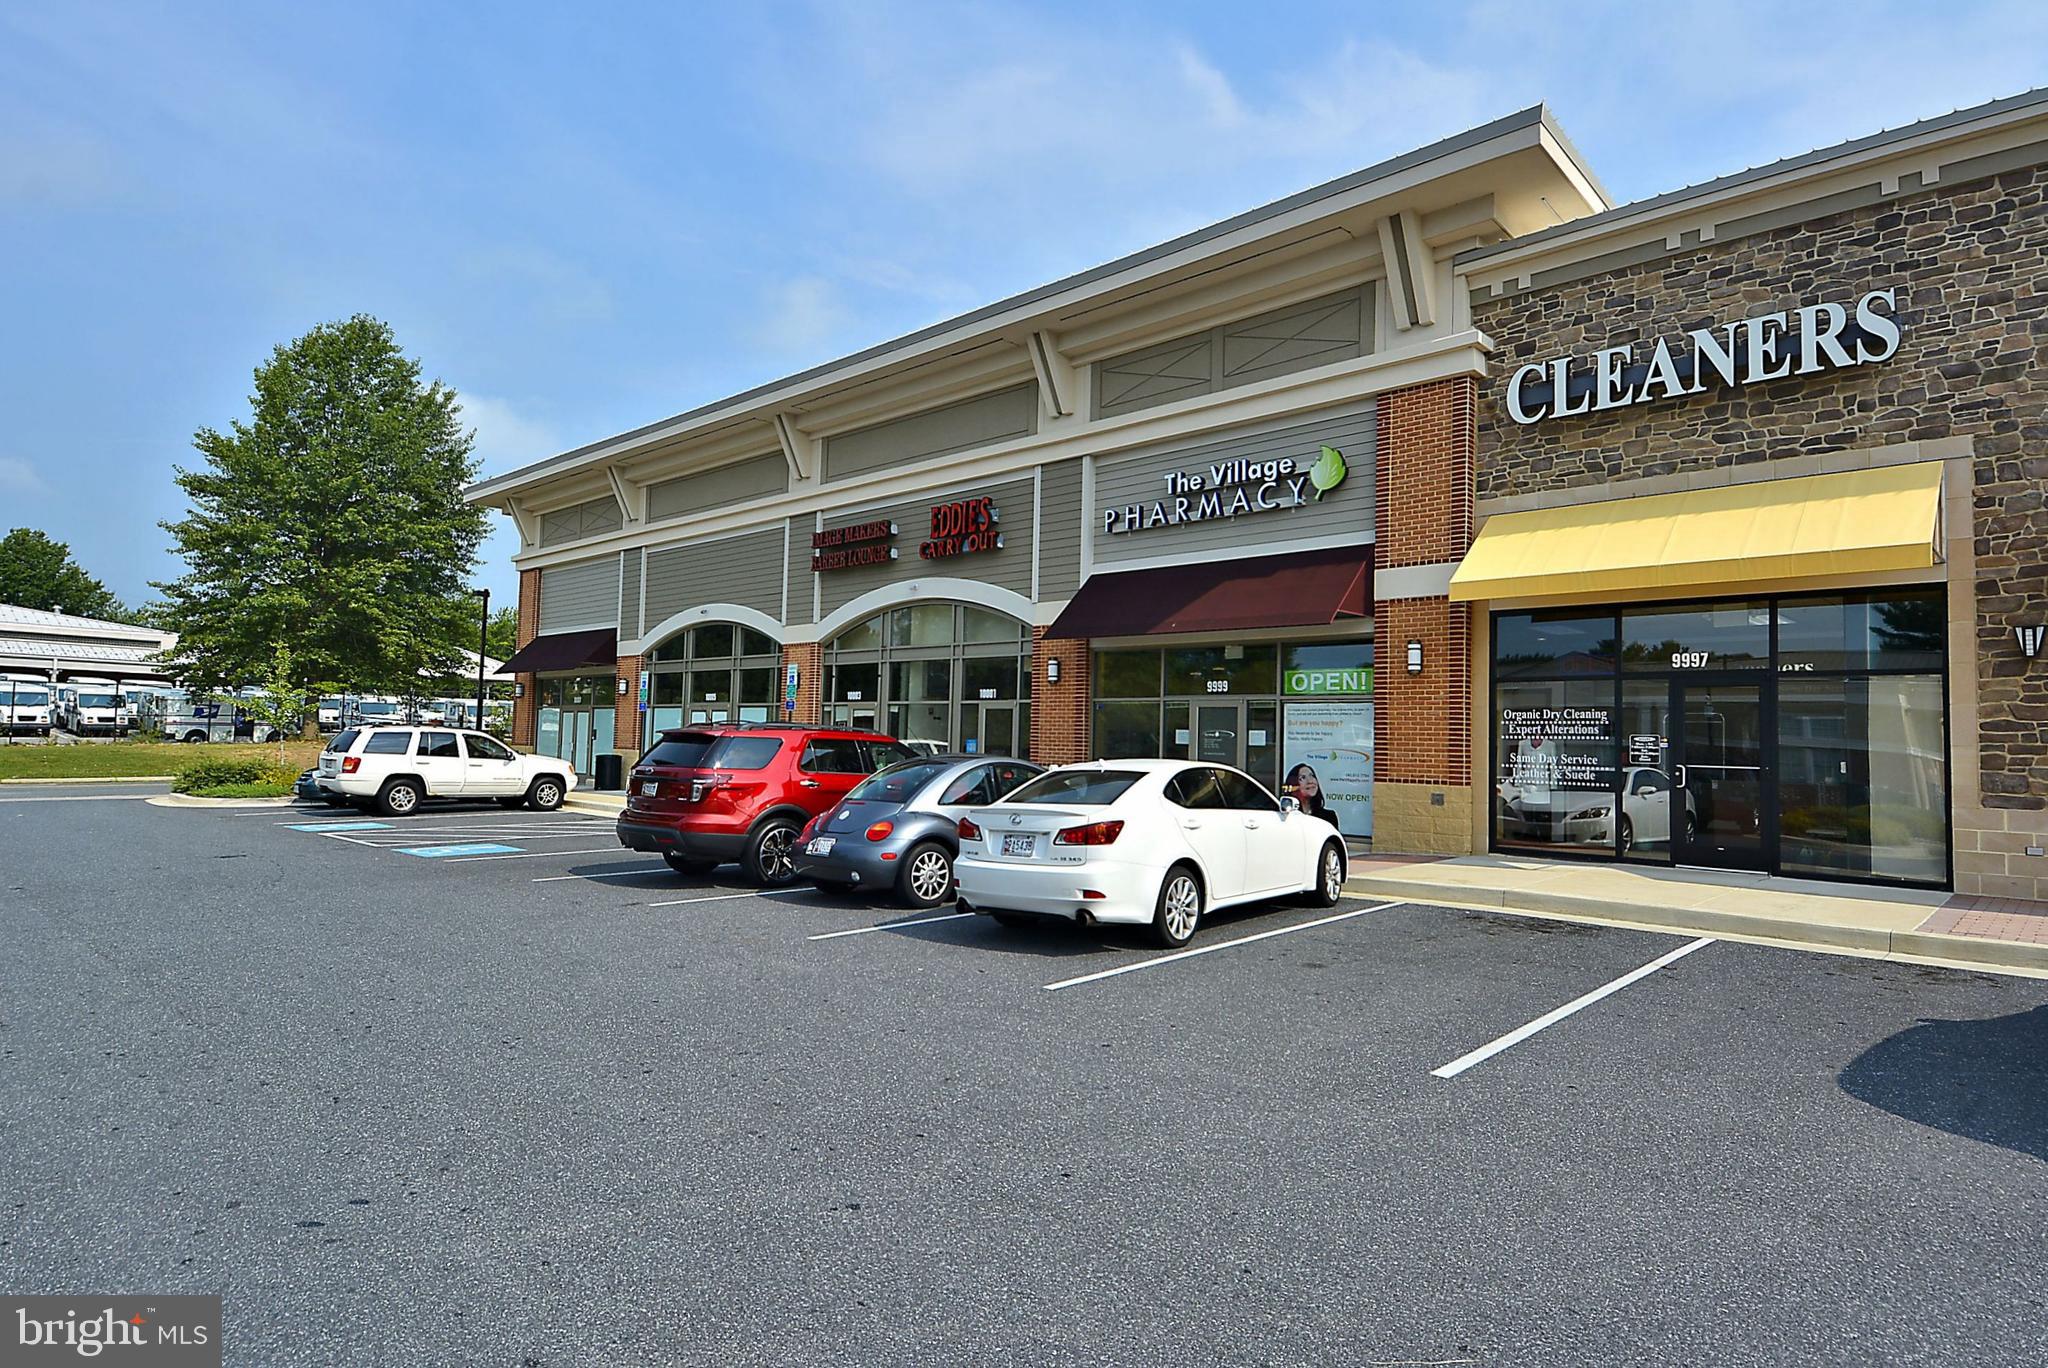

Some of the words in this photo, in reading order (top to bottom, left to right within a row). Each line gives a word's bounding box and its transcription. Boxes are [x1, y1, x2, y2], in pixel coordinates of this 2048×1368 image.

[1506, 288, 1902, 425] CLEANERS
[1164, 472, 1203, 495] The
[1210, 458, 1296, 487] Village
[1104, 476, 1308, 533] PHARMACY
[930, 496, 992, 540] EDDIE'S
[811, 527, 843, 549] IMAGE
[844, 520, 889, 544] MAKERS
[919, 538, 962, 560] CARRY
[967, 530, 998, 552] OUT
[811, 551, 846, 572] BARBER
[847, 544, 889, 567] LOUNGE
[1671, 652, 1709, 668] 9997
[1206, 680, 1229, 693] 9999
[1291, 671, 1367, 691] OPEN!
[1503, 709, 1541, 721] Organic
[1543, 709, 1561, 721] Dry
[1563, 708, 1608, 721] Cleaning
[1508, 724, 1541, 737] Expert
[1543, 724, 1600, 735] Alterations
[1509, 752, 1538, 763] Same
[1539, 753, 1559, 766] Day
[1560, 753, 1599, 766] Service
[1512, 767, 1550, 779] Leather
[1553, 769, 1564, 779] &
[1564, 769, 1596, 781] Suede
[1325, 793, 1344, 801] NOW
